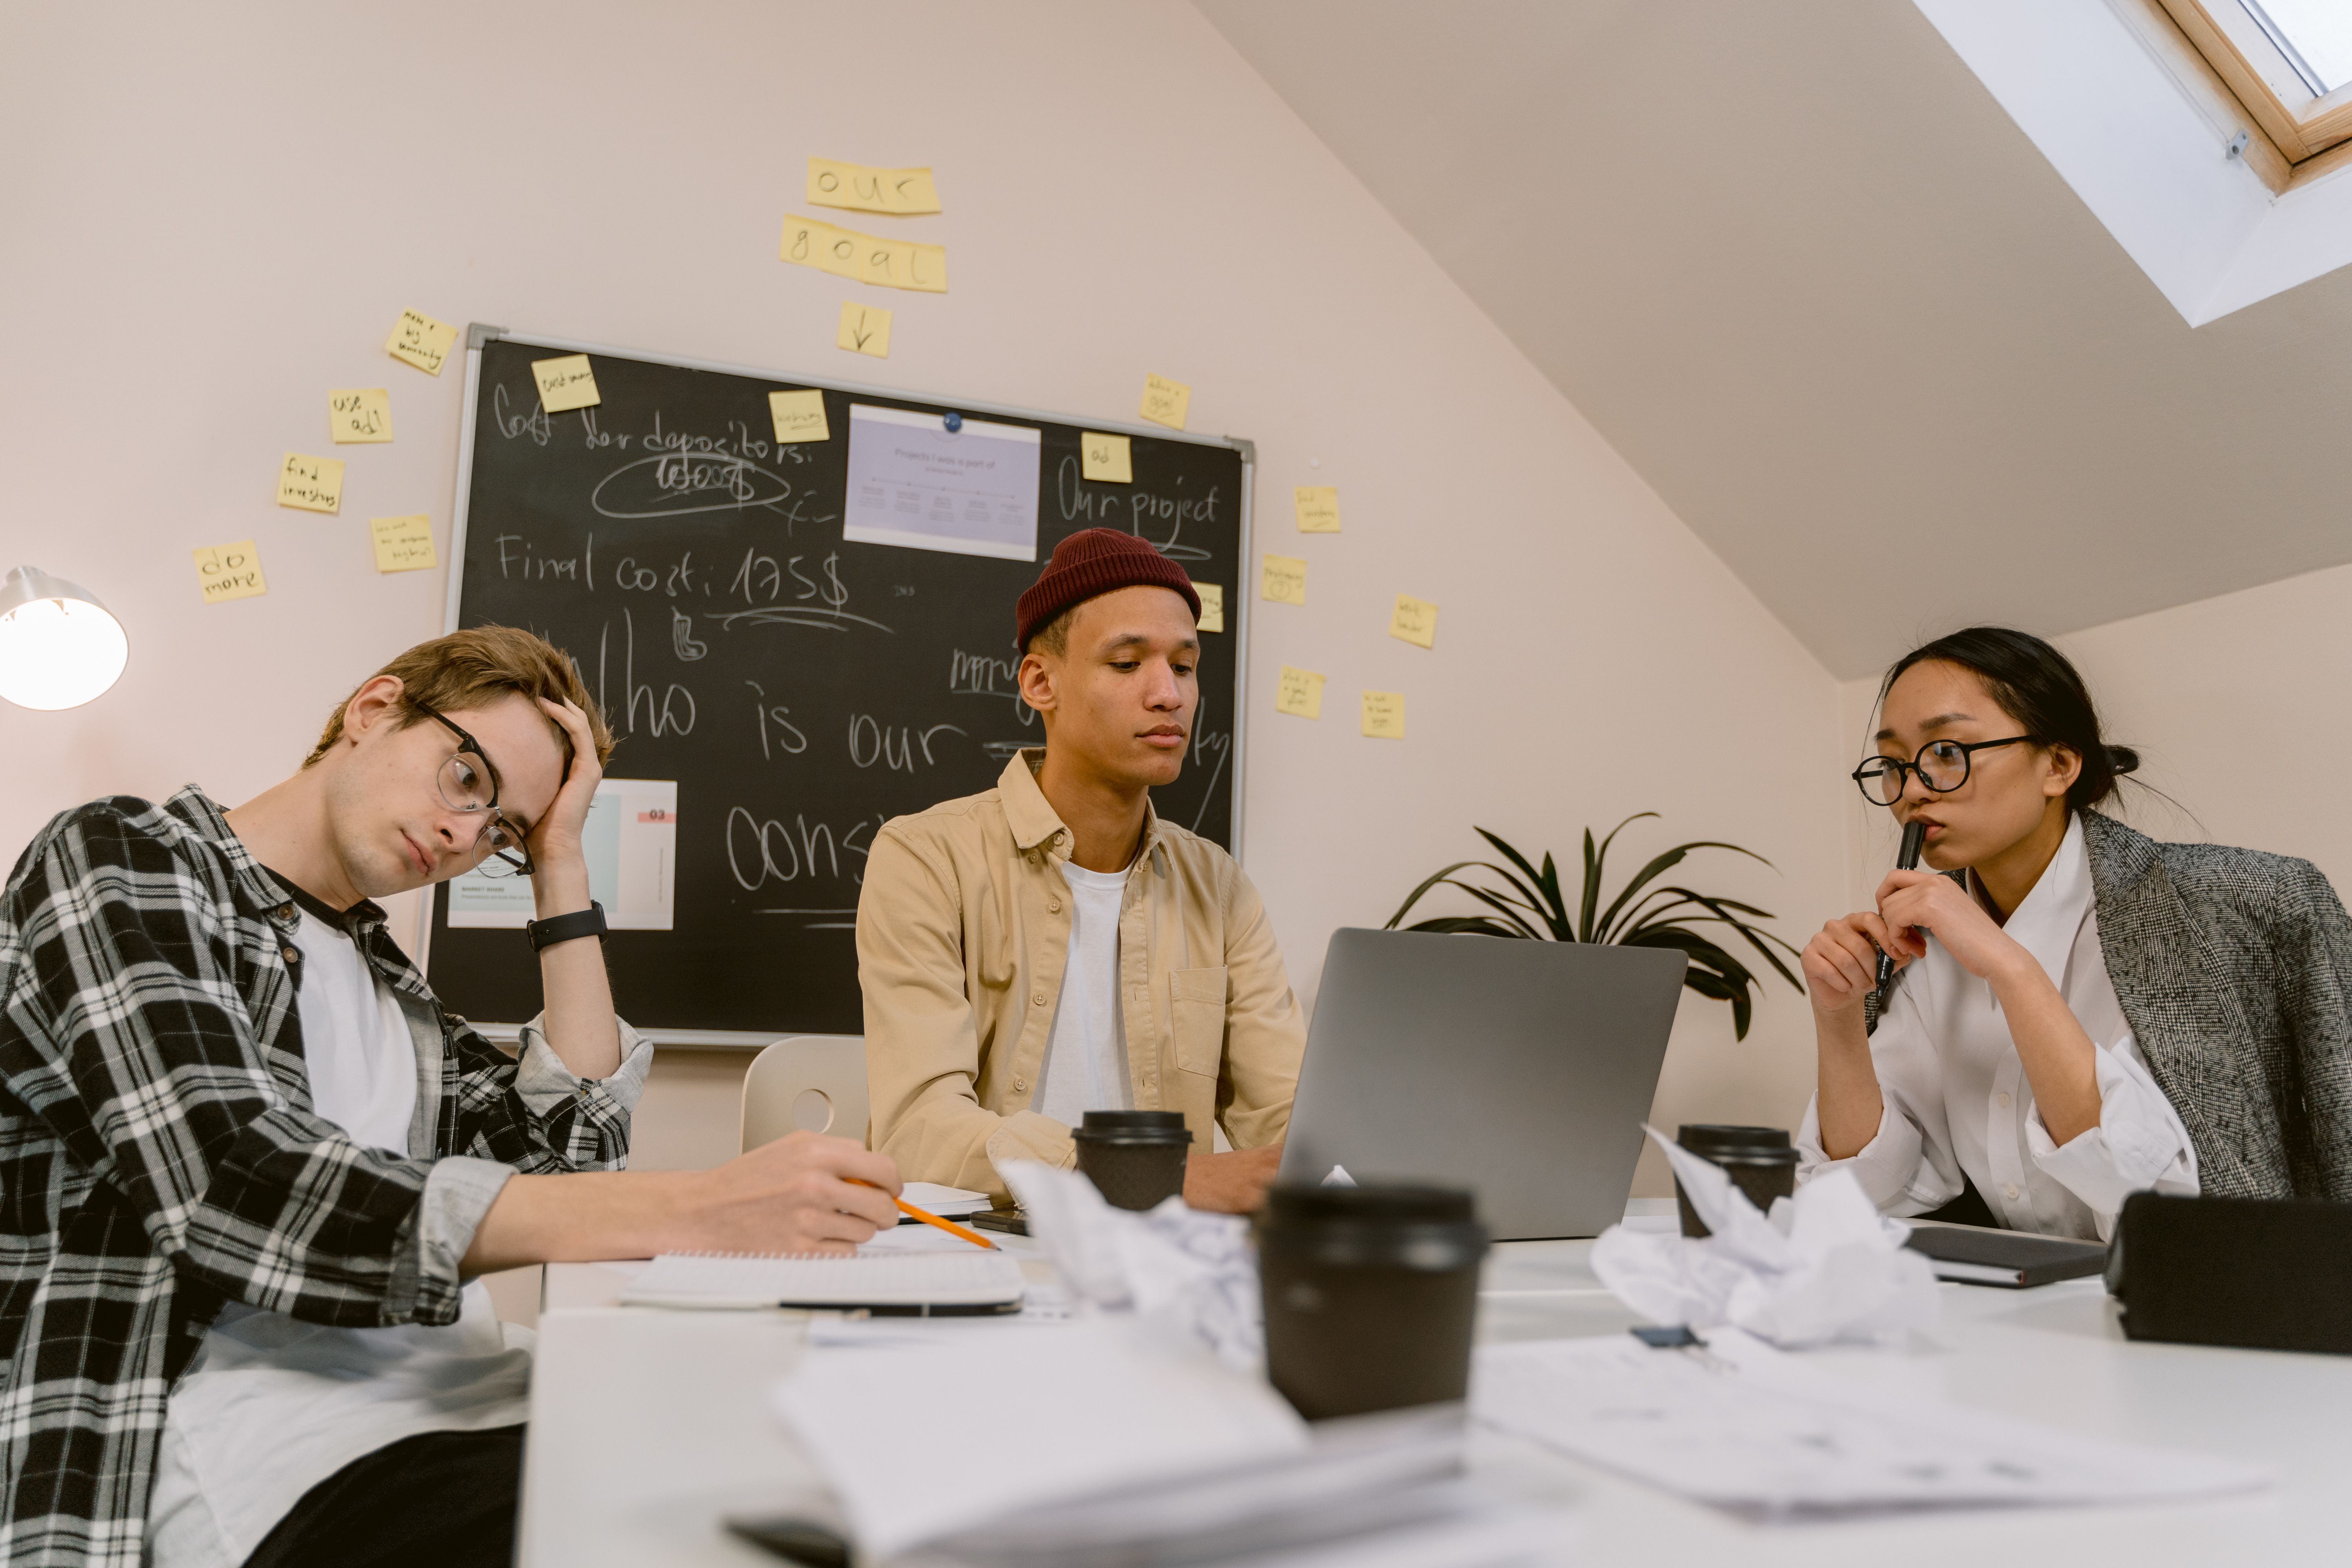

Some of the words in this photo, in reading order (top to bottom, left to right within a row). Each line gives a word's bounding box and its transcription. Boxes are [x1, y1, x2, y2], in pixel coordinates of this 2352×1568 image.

[818, 171, 914, 204] our
[790, 229, 927, 285] goal
[406, 325, 420, 344] big
[334, 395, 361, 412] use
[287, 457, 318, 481] find
[894, 448, 930, 462] Projects
[937, 456, 955, 466] was
[965, 459, 984, 469] part
[1059, 454, 1119, 521] Our
[1132, 475, 1219, 552] project
[202, 549, 245, 575] do
[204, 571, 260, 595] more
[495, 532, 593, 591] Final
[729, 547, 849, 619] 175$
[745, 680, 807, 761] is
[650, 809, 665, 820] 03
